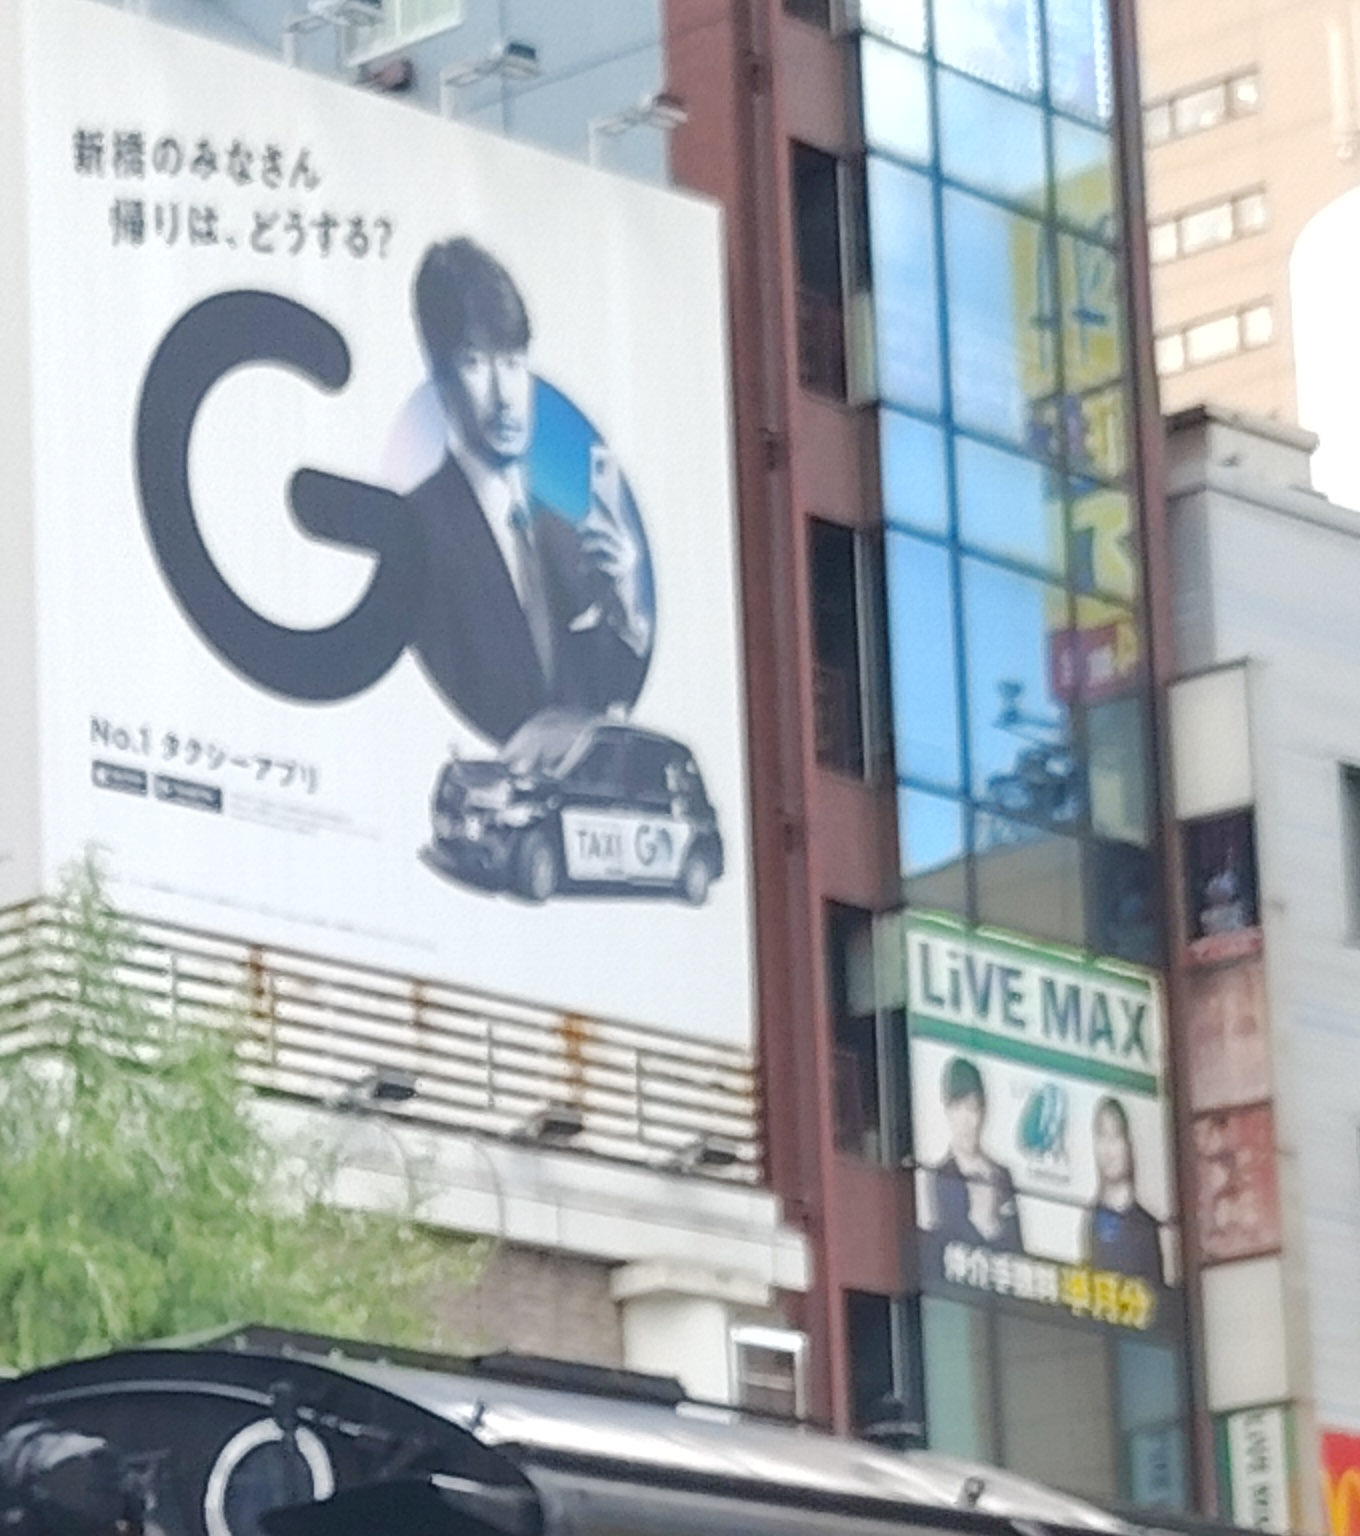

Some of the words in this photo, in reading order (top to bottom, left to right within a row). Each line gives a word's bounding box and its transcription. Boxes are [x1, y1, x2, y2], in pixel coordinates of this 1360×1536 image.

[160, 731, 319, 795] タクシーアプリ
[1038, 974, 1149, 1063] MAX
